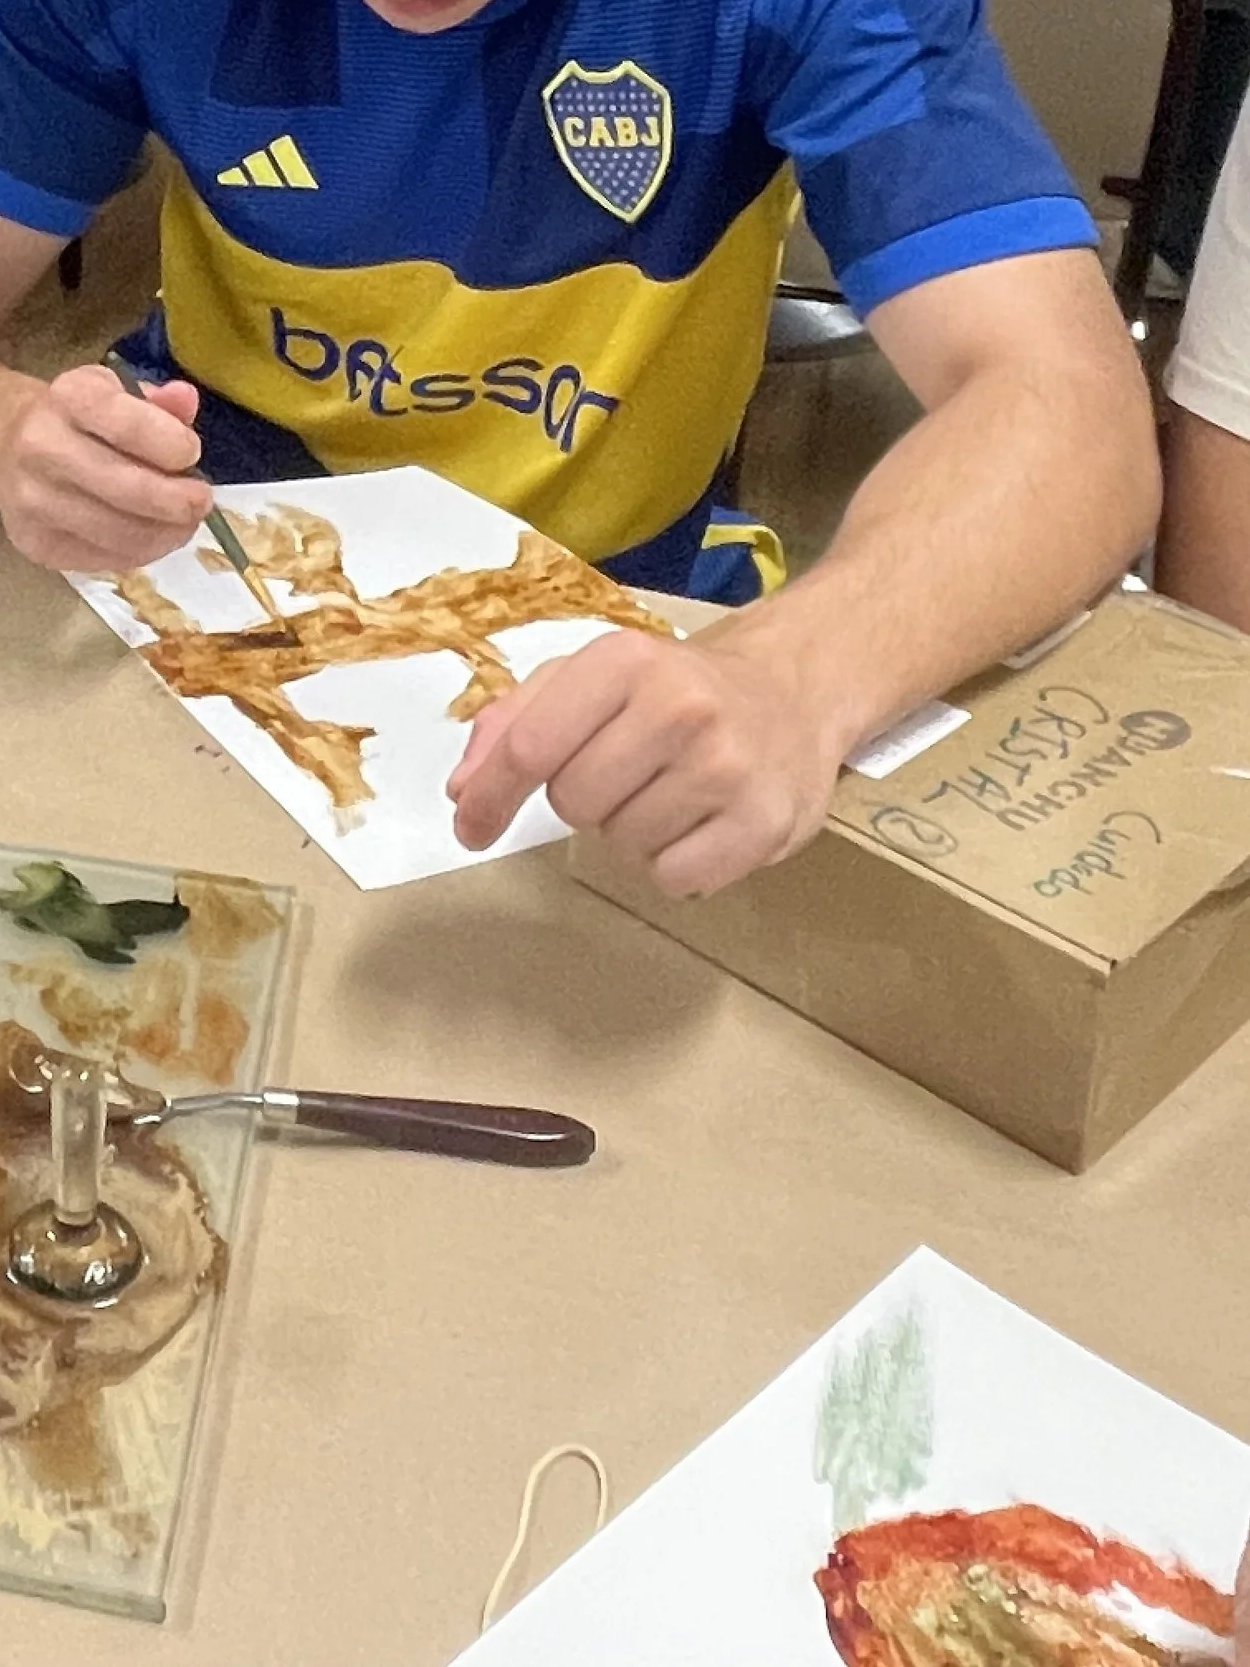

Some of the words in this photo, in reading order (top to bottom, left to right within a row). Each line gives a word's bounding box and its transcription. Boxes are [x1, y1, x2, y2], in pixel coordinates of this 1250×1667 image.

[563, 116, 660, 148] CABJ
[921, 686, 1109, 814] CRISTAL
[1033, 811, 1161, 897] Cuidado
